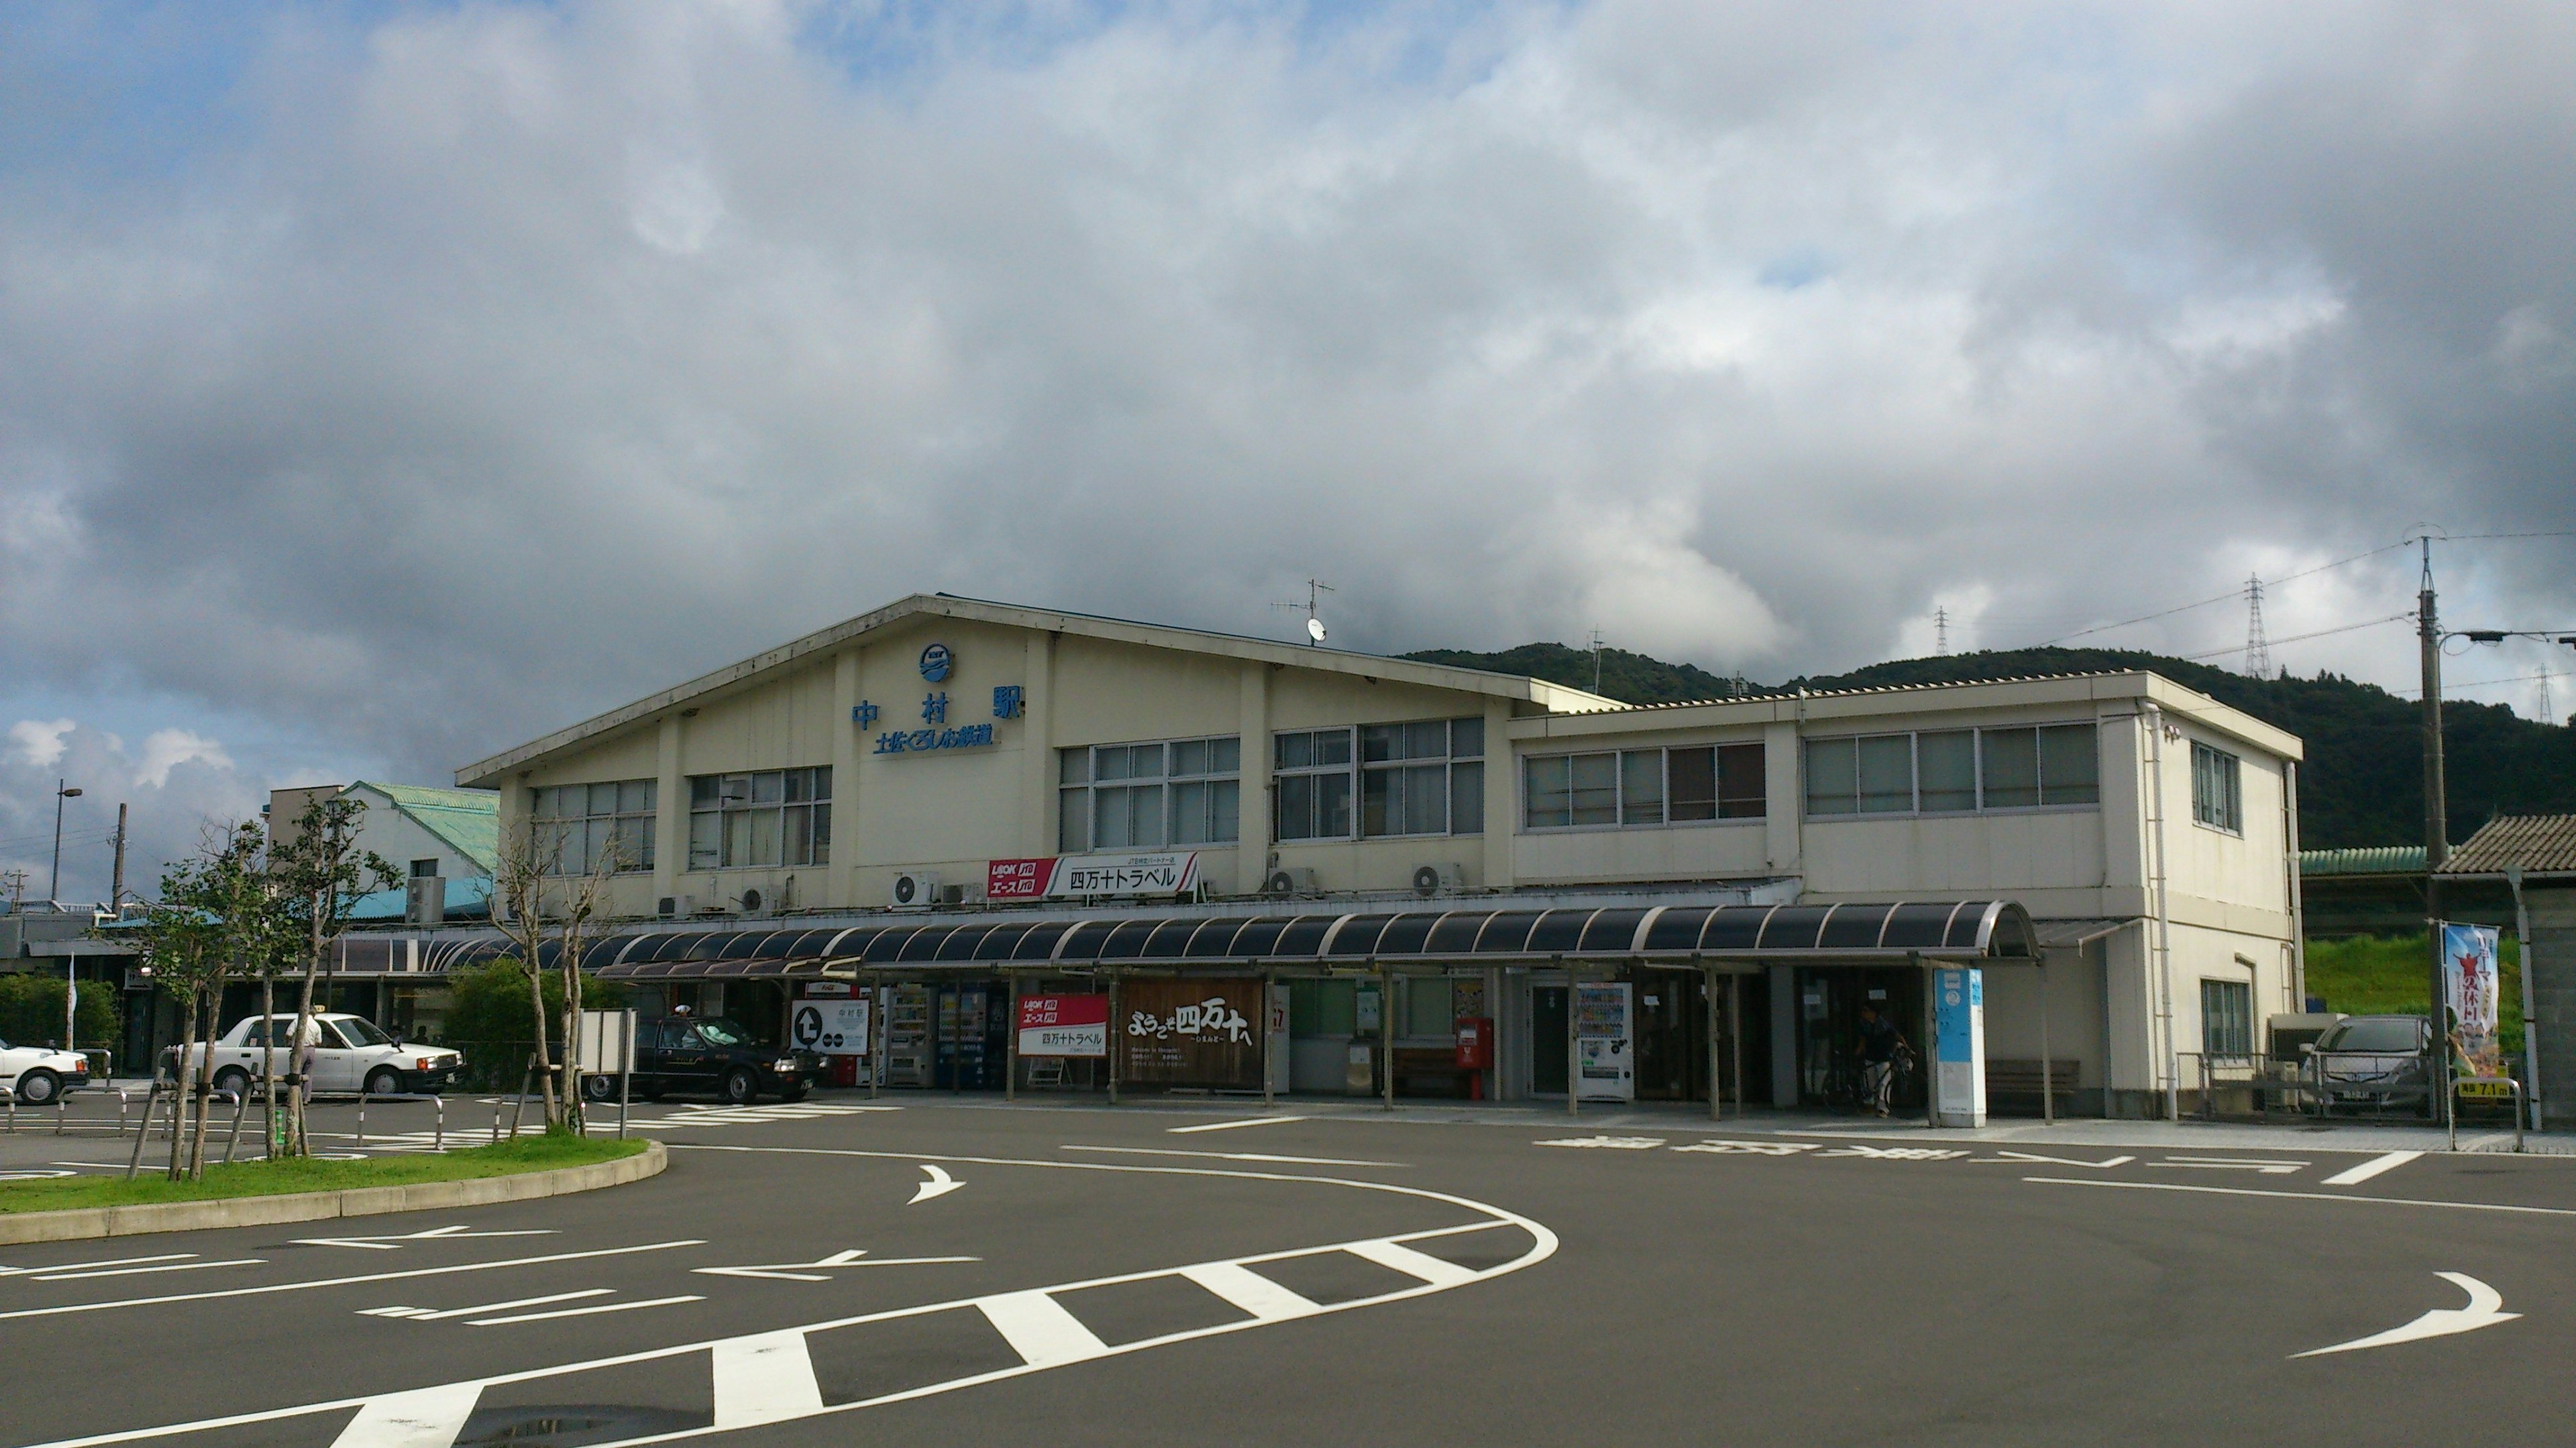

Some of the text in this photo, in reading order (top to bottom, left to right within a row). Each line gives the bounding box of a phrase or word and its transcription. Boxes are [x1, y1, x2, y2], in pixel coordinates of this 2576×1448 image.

[853, 685, 1020, 730] 中村駅
[873, 724, 993, 754] 土佐くろしお鉄道
[991, 863, 1036, 878] LOOK JTB
[1071, 868, 1176, 890] 四万十トラベル
[990, 880, 1035, 893] エース JTB
[1024, 1000, 1043, 1011] LOOK
[1024, 1013, 1043, 1023] エース
[1128, 997, 1252, 1046] ようこそ四万十へ
[1042, 1033, 1102, 1044] 四万十トラベル
[2479, 1082, 2496, 1095] 7.1
